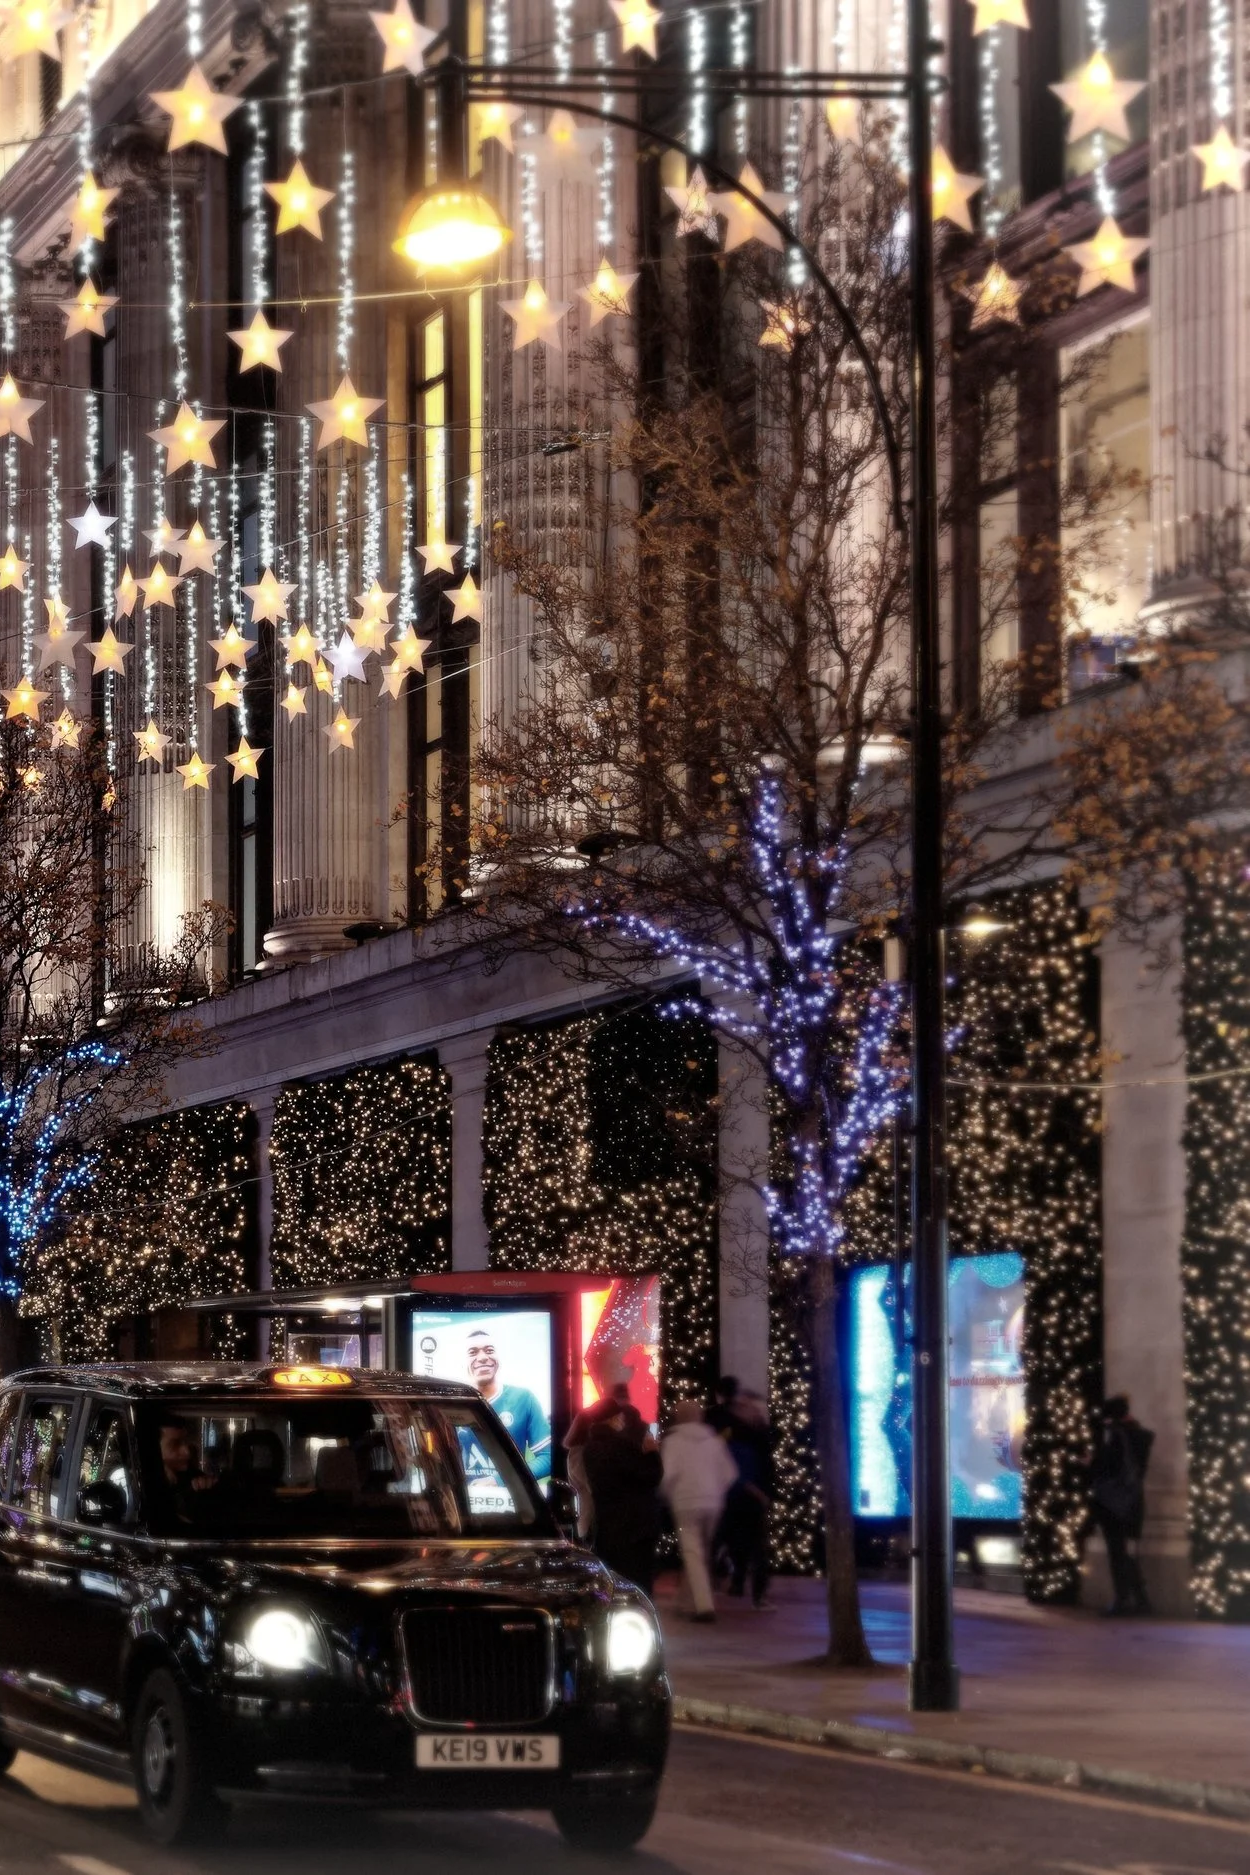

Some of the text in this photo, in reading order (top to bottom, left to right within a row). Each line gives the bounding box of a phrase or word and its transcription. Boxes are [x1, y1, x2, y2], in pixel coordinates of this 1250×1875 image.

[424, 1355, 434, 1376] FIF
[281, 1373, 345, 1383] TAXI
[432, 1738, 543, 1762] KE19 VWS
